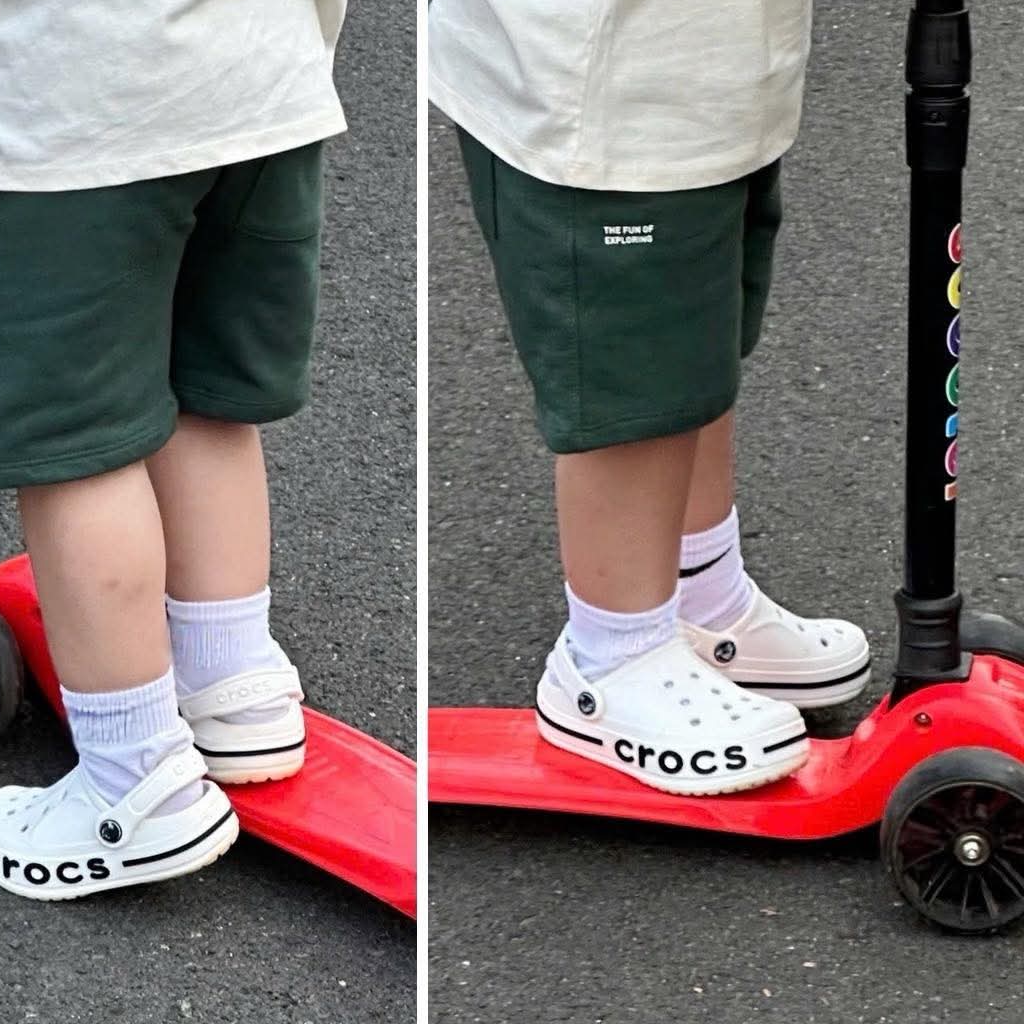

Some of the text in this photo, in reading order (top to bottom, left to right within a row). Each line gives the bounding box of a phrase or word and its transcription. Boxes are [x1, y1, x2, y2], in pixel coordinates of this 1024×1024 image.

[603, 224, 654, 235] THE FUN OF
[613, 737, 747, 775] crocs
